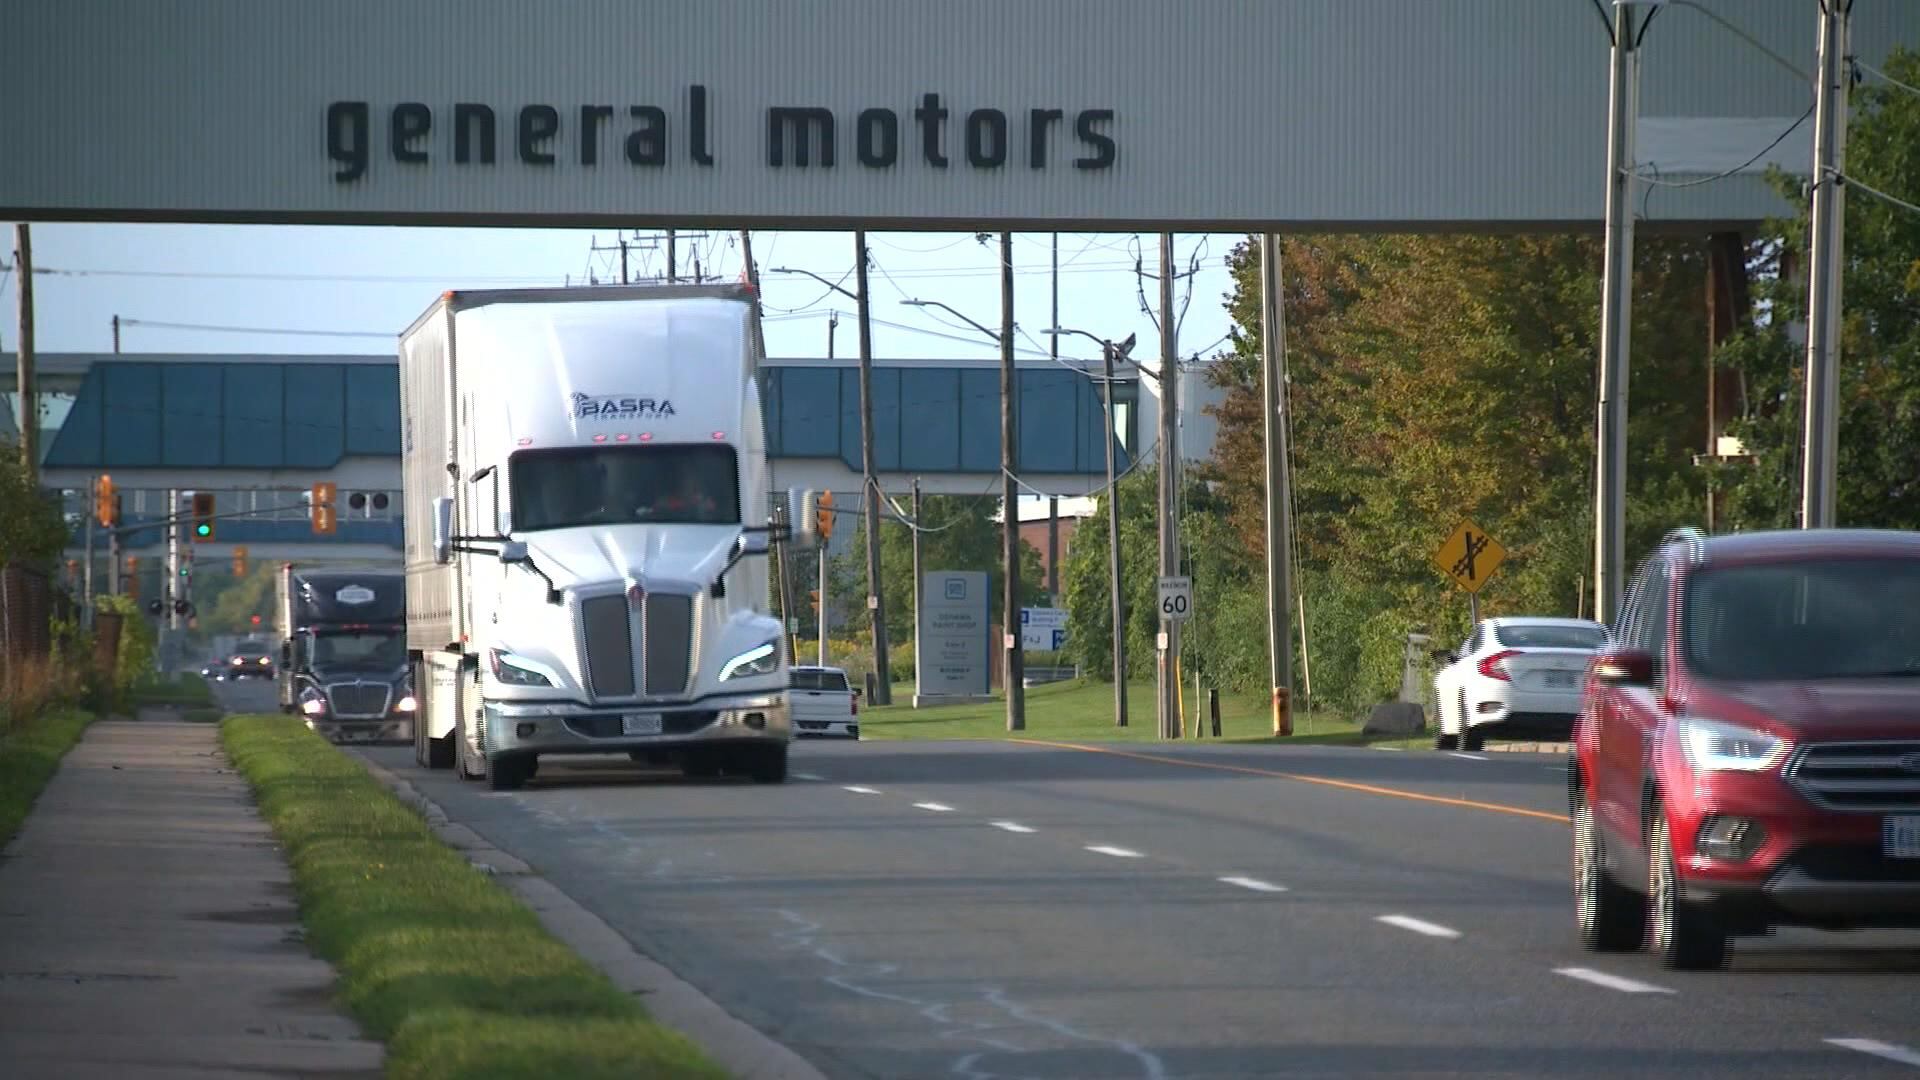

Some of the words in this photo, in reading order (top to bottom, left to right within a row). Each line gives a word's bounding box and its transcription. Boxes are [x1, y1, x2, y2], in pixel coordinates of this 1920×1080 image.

[326, 85, 714, 183] general
[766, 93, 1117, 169] motors
[580, 398, 675, 416] BASRA
[1163, 595, 1187, 613] 60
